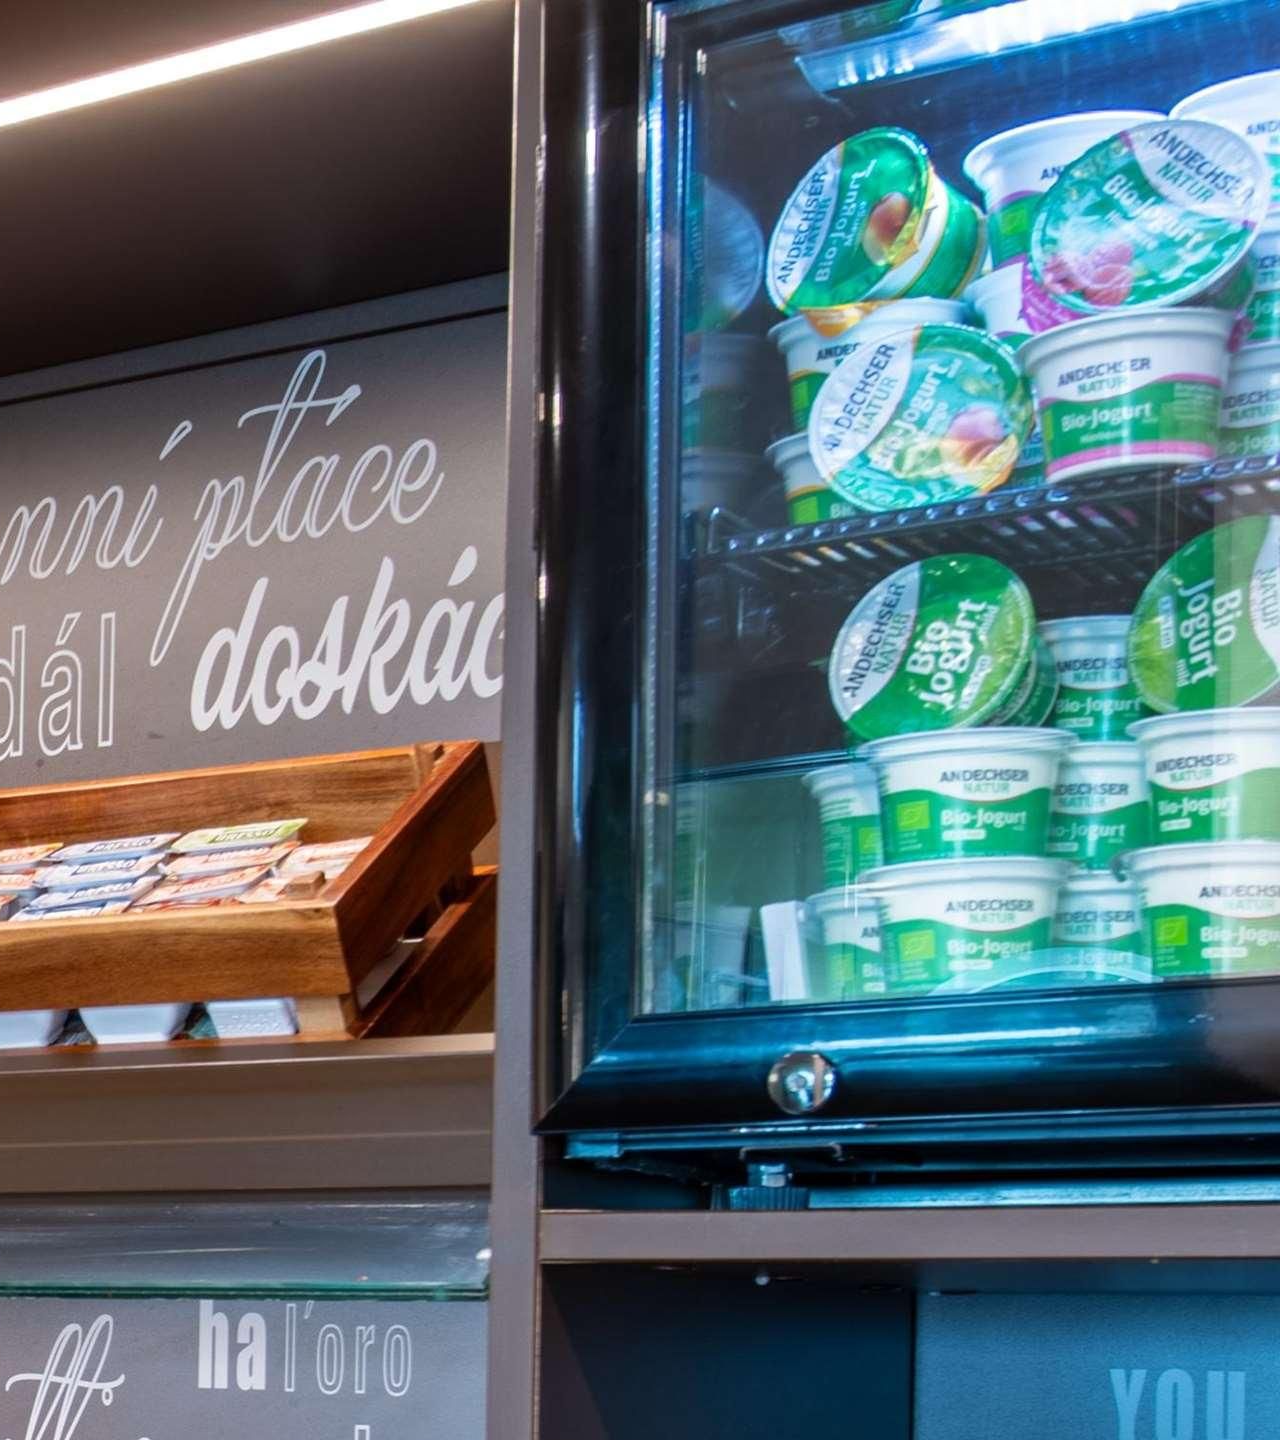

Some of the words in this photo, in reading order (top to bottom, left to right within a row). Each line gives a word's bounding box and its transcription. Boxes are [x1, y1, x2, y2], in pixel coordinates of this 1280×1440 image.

[776, 168, 828, 284] ANDECHSER
[853, 374, 900, 436] NATUR
[1060, 402, 1153, 432] Bio-Jogurt
[841, 582, 906, 698] ANDECHSER
[905, 619, 950, 675] Bio
[1177, 577, 1220, 685] Jogurt
[1212, 588, 1244, 647] Bio
[918, 598, 988, 712] Jogurt
[940, 768, 1030, 783] ANDECHSER
[940, 807, 1028, 829] Bio-Jogurt
[946, 898, 1035, 914] ANDECHSER
[945, 939, 1034, 960] Bio-Jogurt
[197, 1299, 268, 1392] ha
